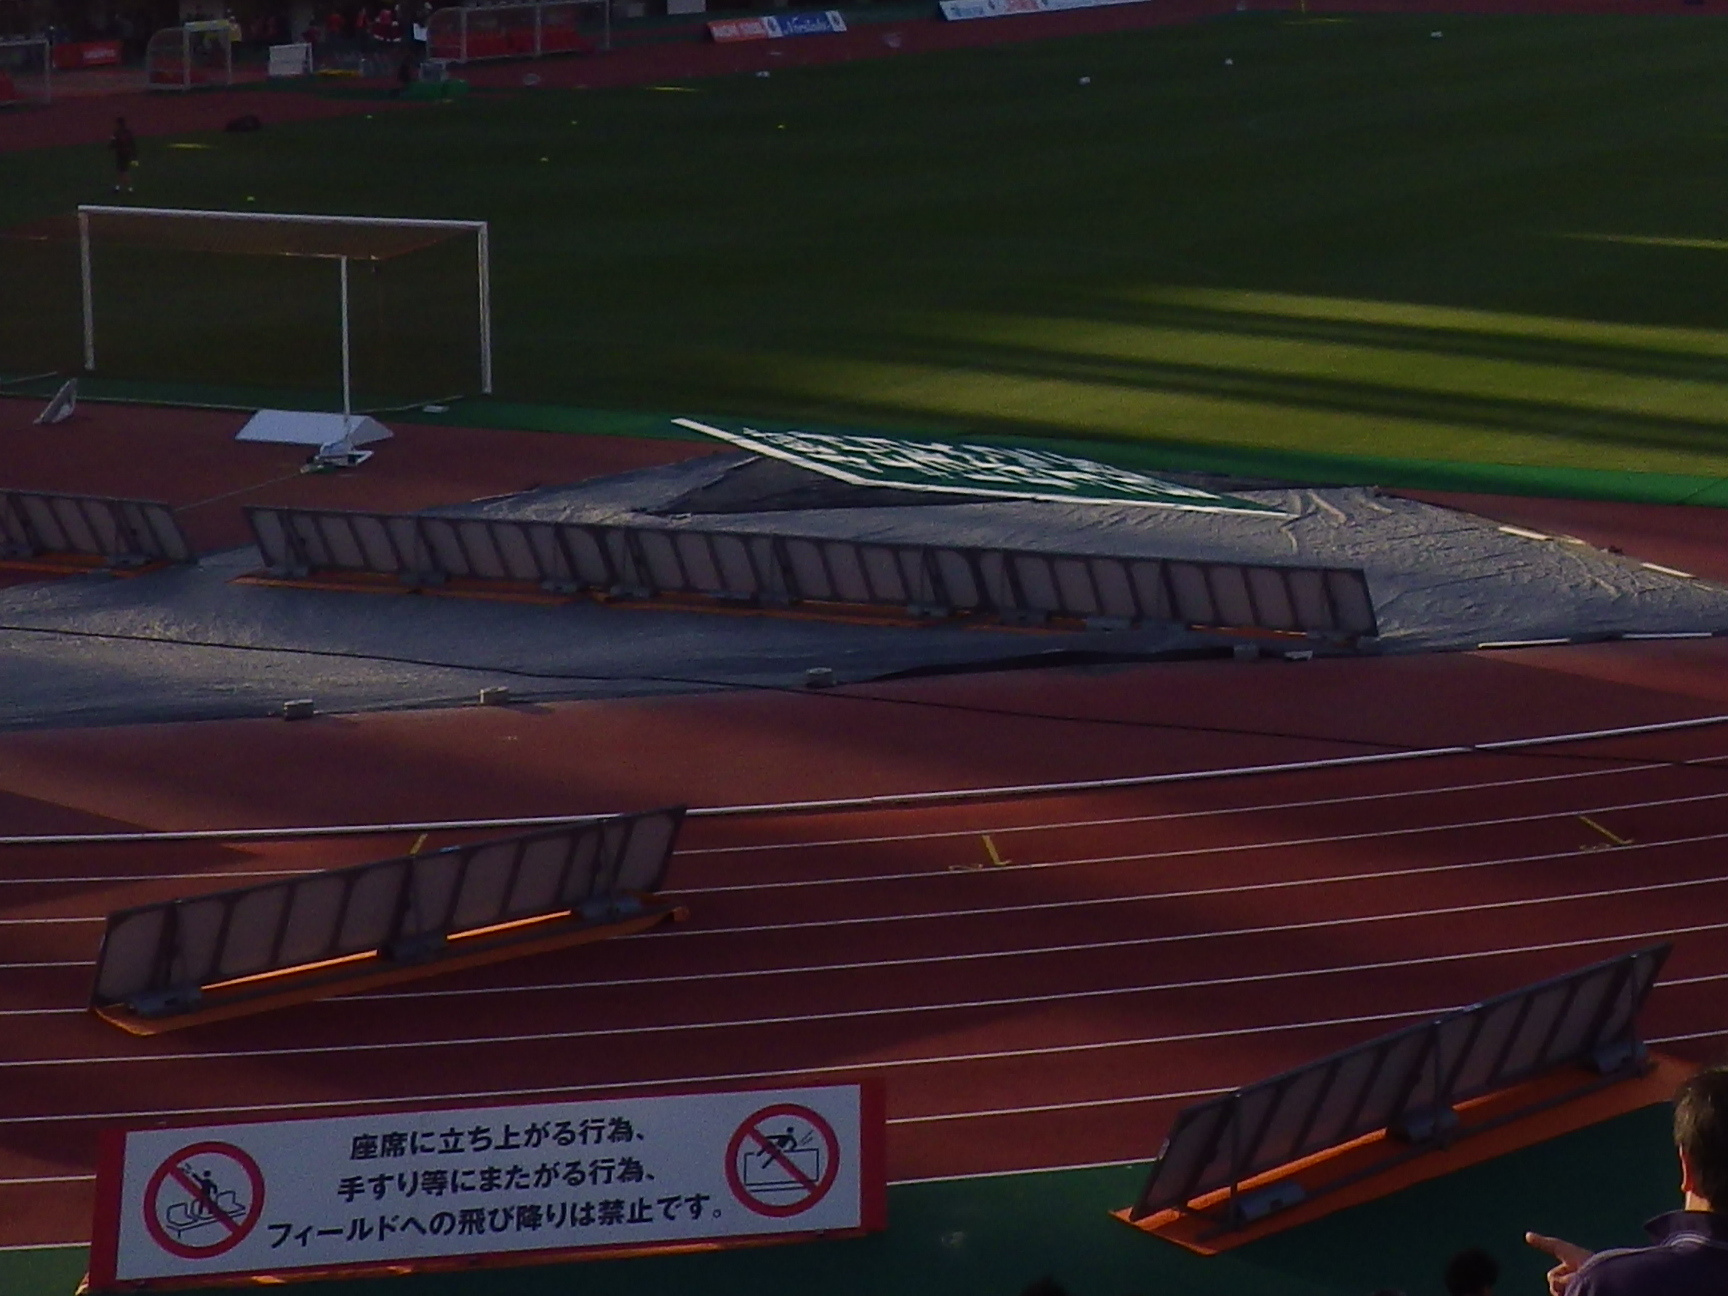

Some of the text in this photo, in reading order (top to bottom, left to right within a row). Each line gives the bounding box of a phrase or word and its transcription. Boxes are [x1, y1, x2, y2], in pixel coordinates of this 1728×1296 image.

[350, 1116, 645, 1160] 座席に立ち上がる行為、
[336, 1163, 658, 1204] 手すり等にまたがる行為、
[267, 1192, 724, 1248] フィールドへの飛び降りは禁止です。
